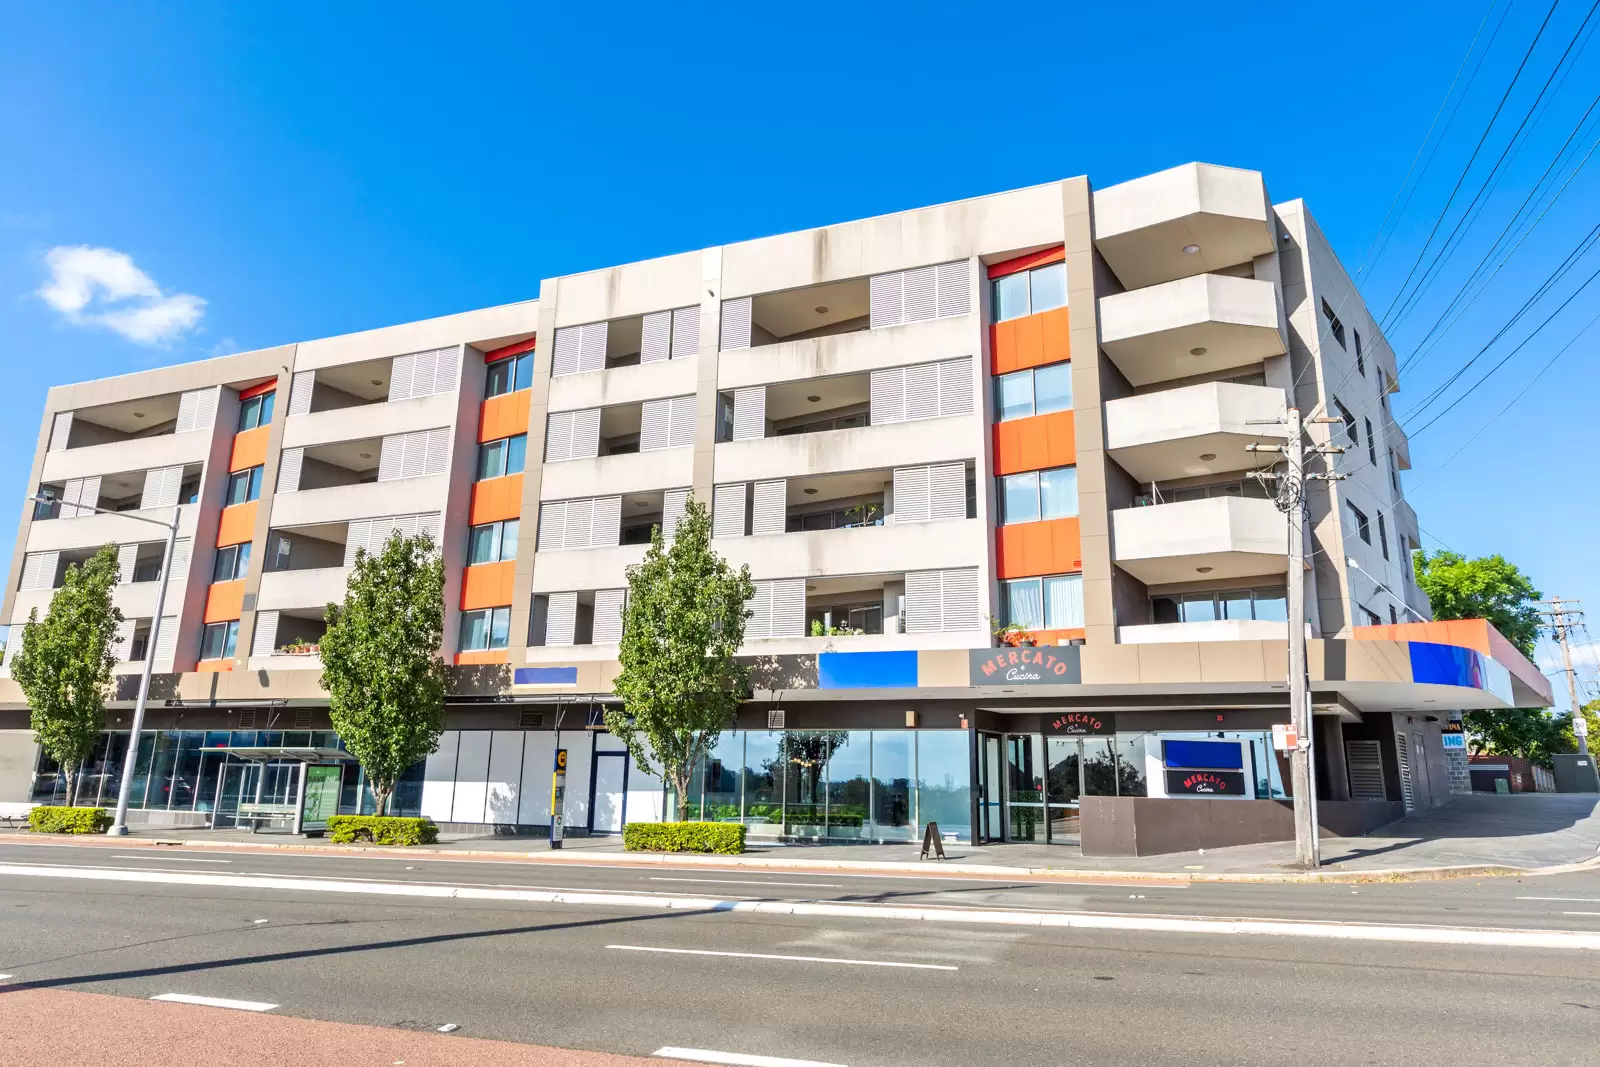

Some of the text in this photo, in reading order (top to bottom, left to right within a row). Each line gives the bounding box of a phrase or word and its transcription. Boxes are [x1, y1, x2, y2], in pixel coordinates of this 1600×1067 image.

[981, 649, 1067, 676] MERCATO
[1006, 667, 1040, 680] Cucina
[1052, 713, 1102, 729] MERCATO
[1183, 773, 1226, 789] MERCATO
